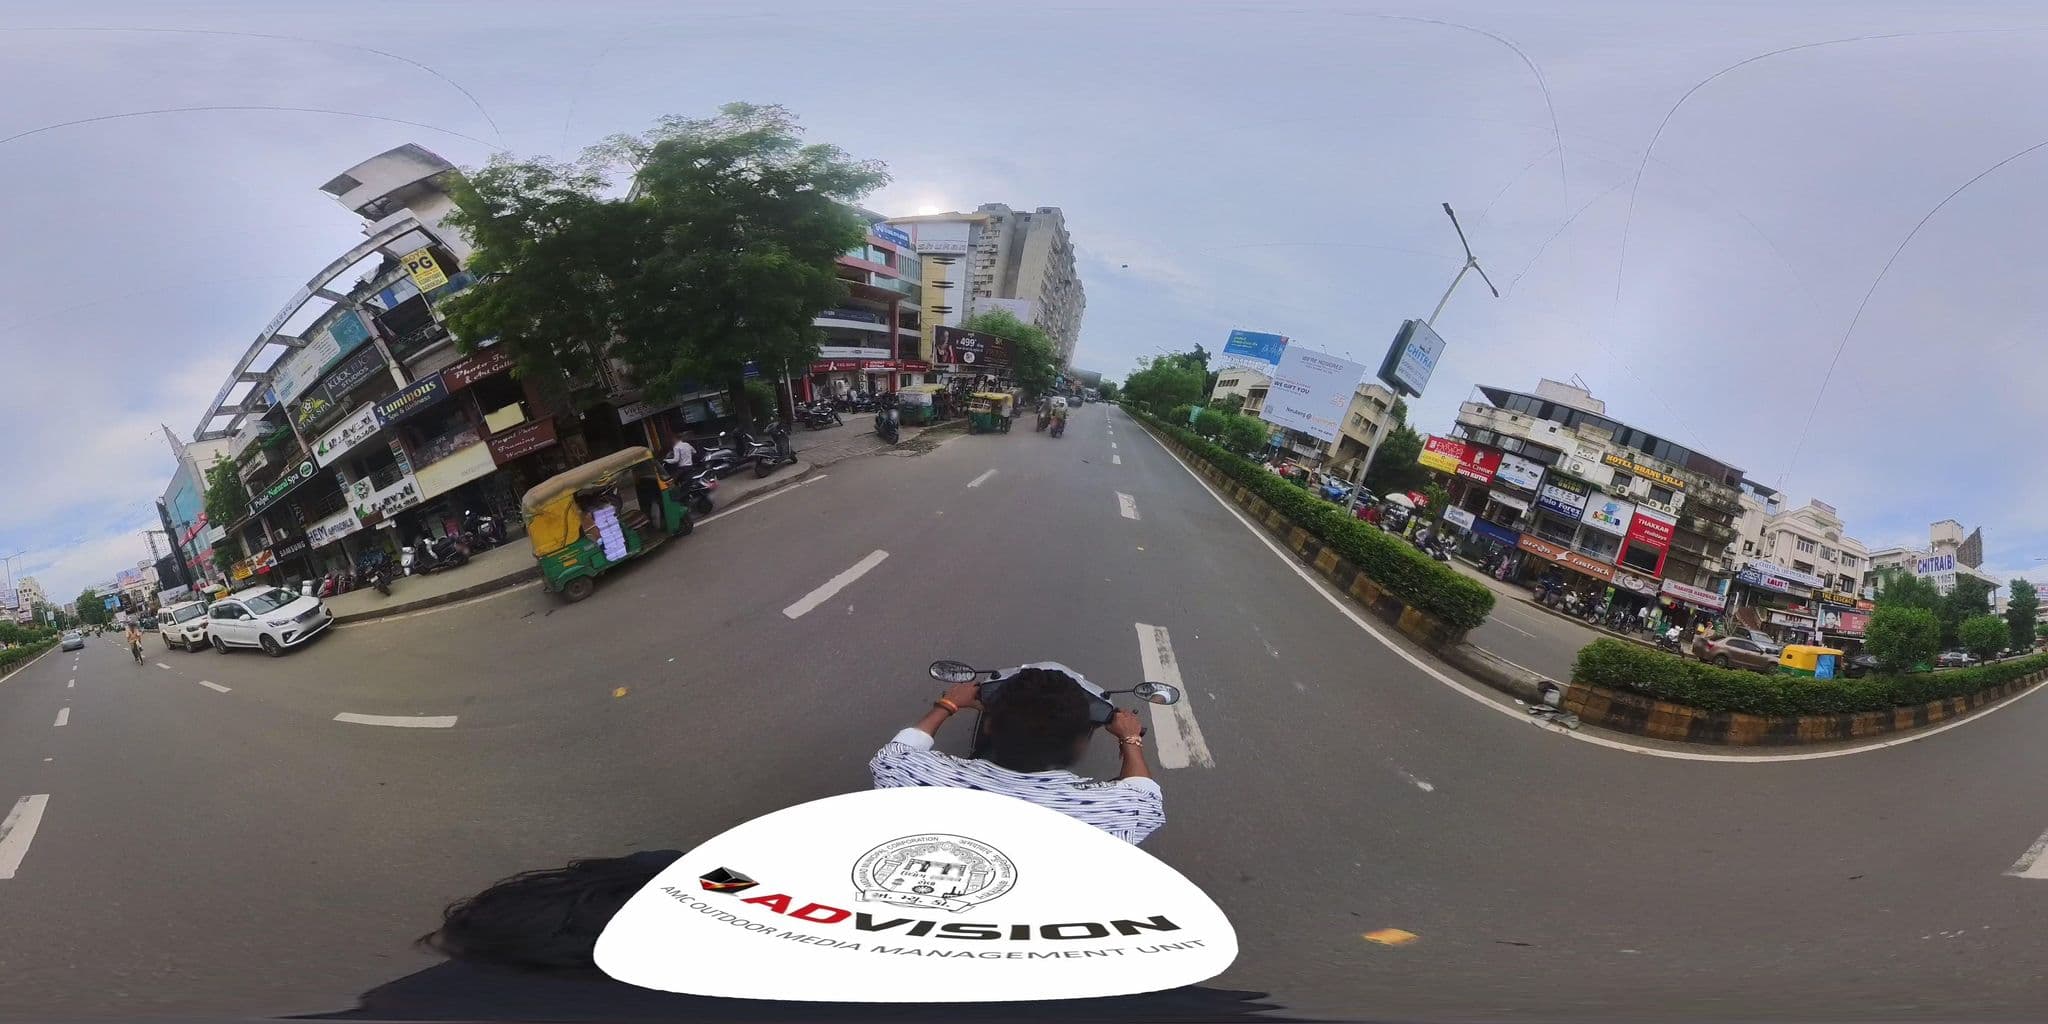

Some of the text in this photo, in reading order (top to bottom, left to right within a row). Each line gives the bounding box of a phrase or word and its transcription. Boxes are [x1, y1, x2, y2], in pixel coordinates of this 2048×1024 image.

[407, 256, 433, 275] PG
[377, 380, 437, 417] Luminous
[287, 472, 299, 486] Spa
[1606, 454, 1633, 469] HOTEL
[1662, 472, 1684, 488] VILLA
[1558, 501, 1581, 517] Forex
[1637, 517, 1670, 534] THAKKAR
[307, 526, 328, 545] HEM
[279, 540, 306, 557] SAMSUNG
